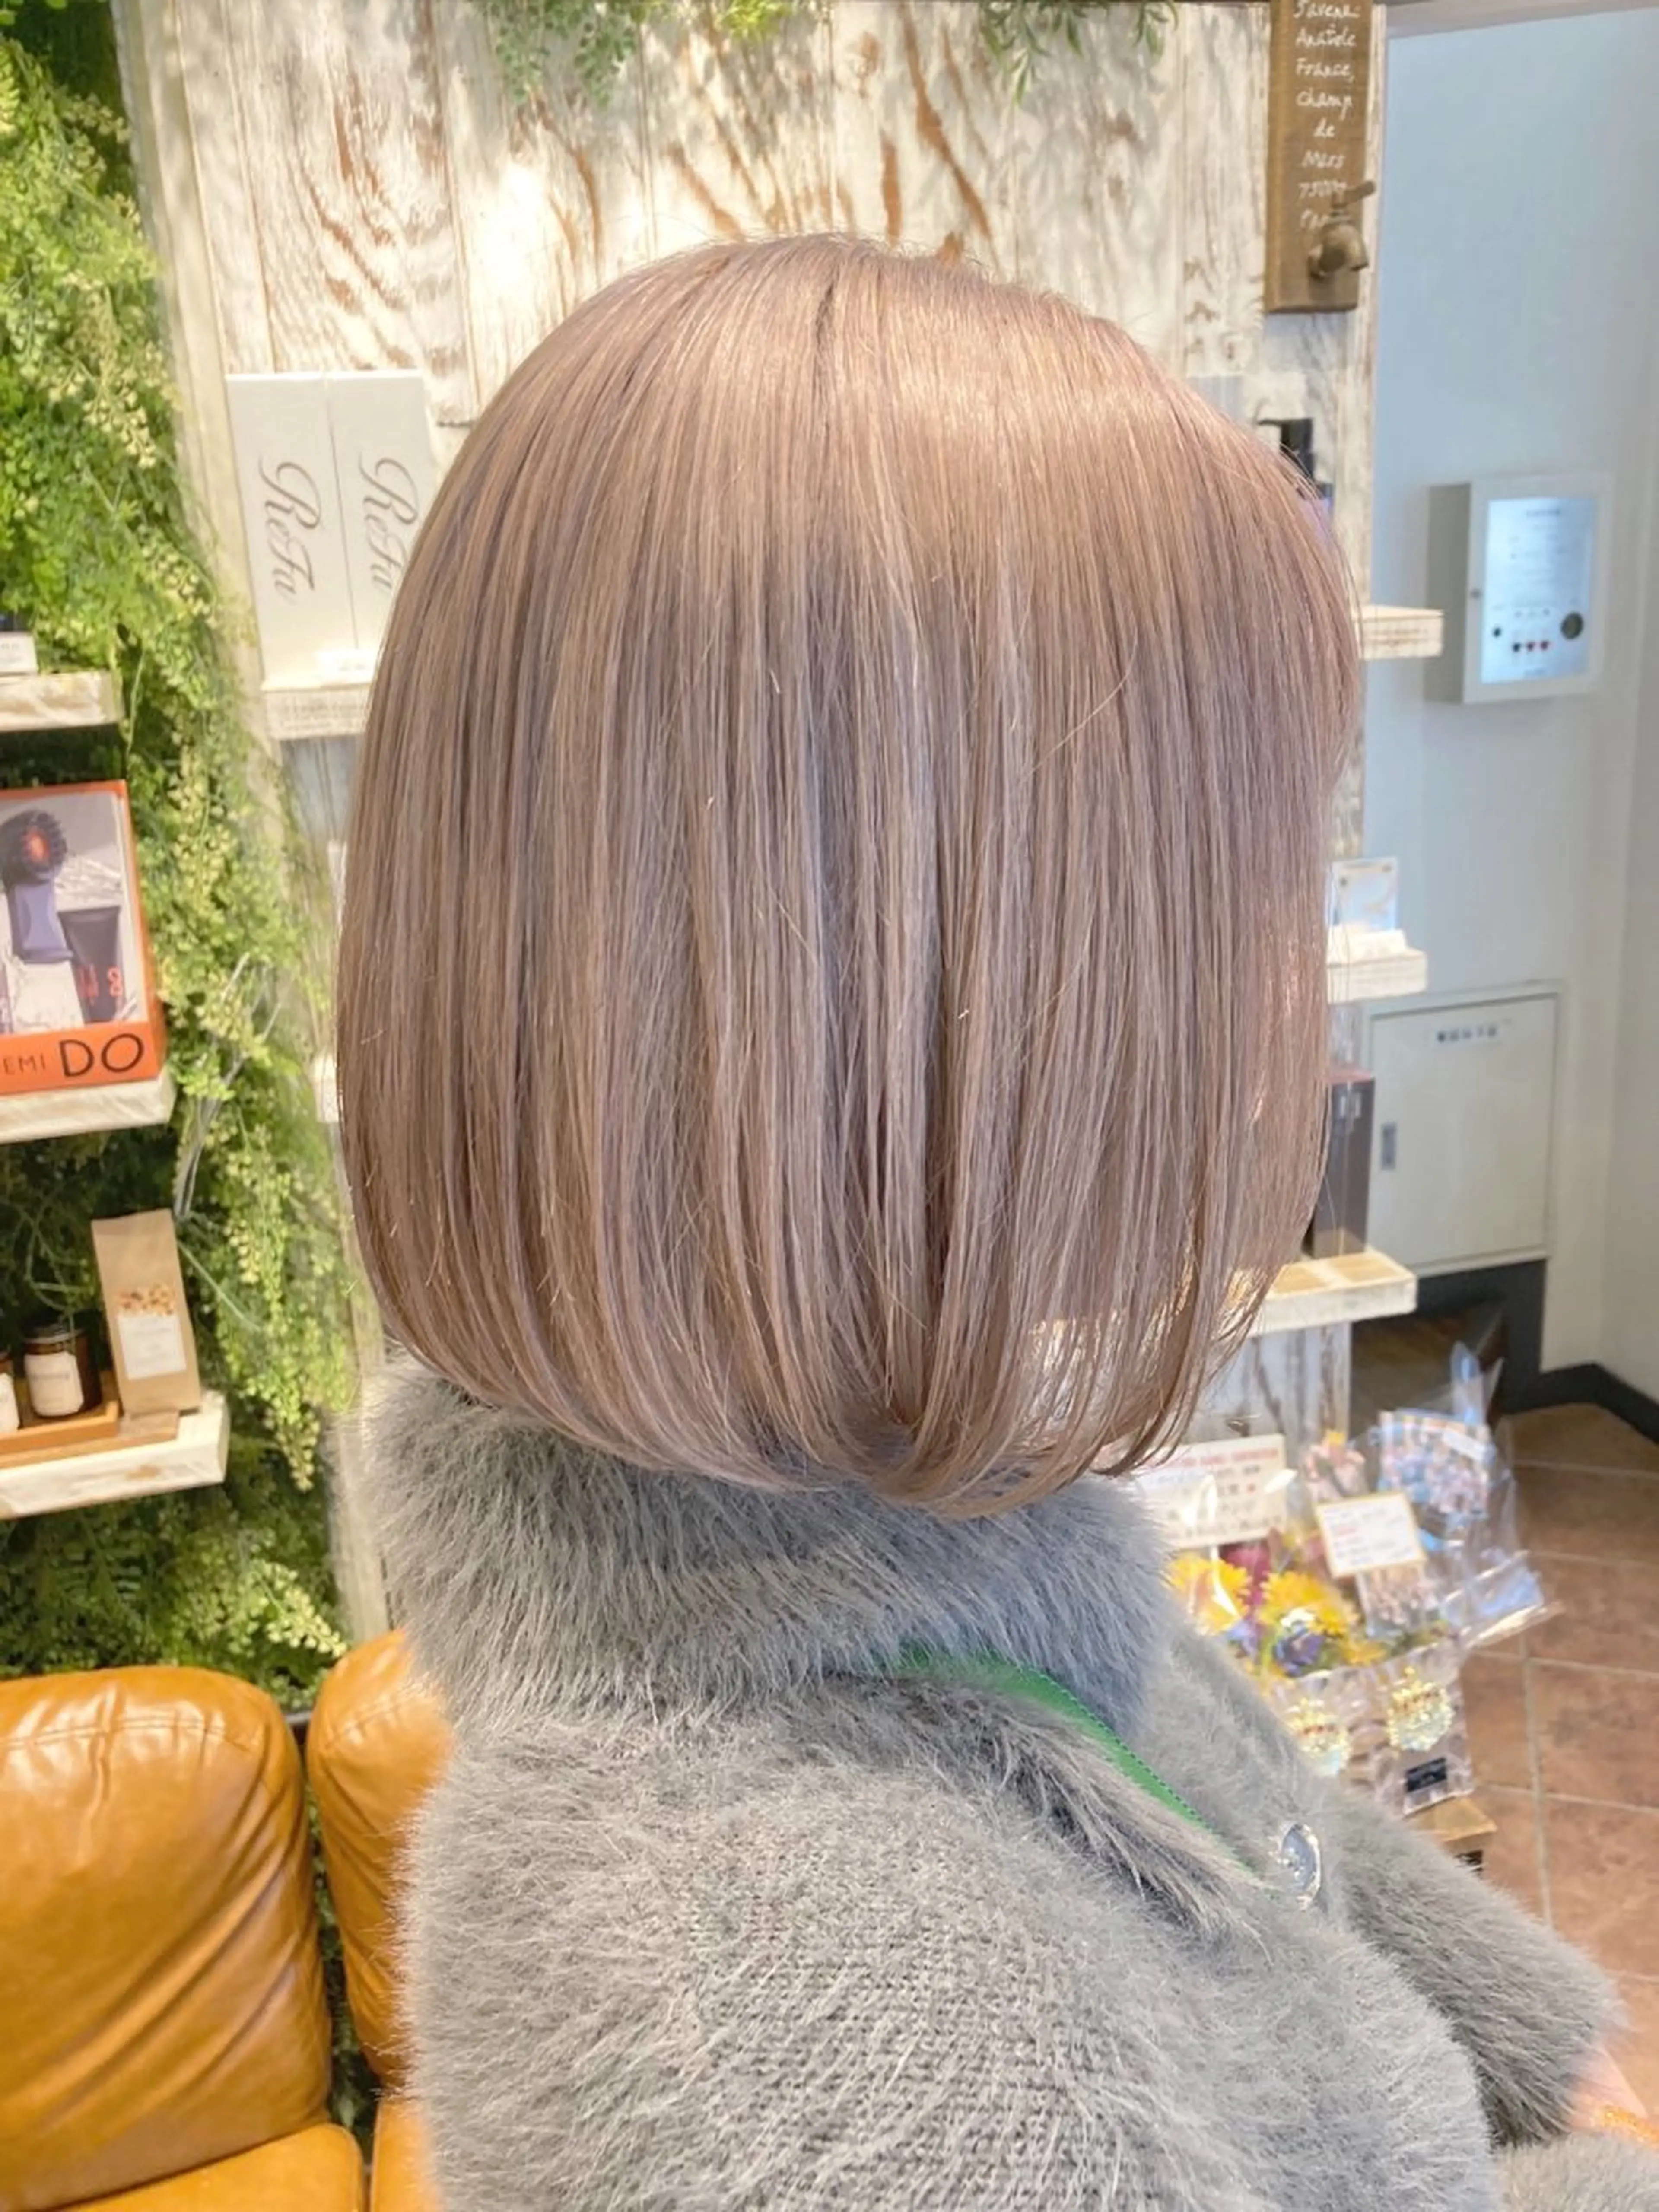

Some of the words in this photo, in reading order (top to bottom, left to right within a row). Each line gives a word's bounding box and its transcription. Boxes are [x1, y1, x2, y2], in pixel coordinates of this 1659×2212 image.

[259, 456, 322, 603] ReFa
[359, 452, 420, 597] ReFa
[60, 1033, 144, 1077] DO
